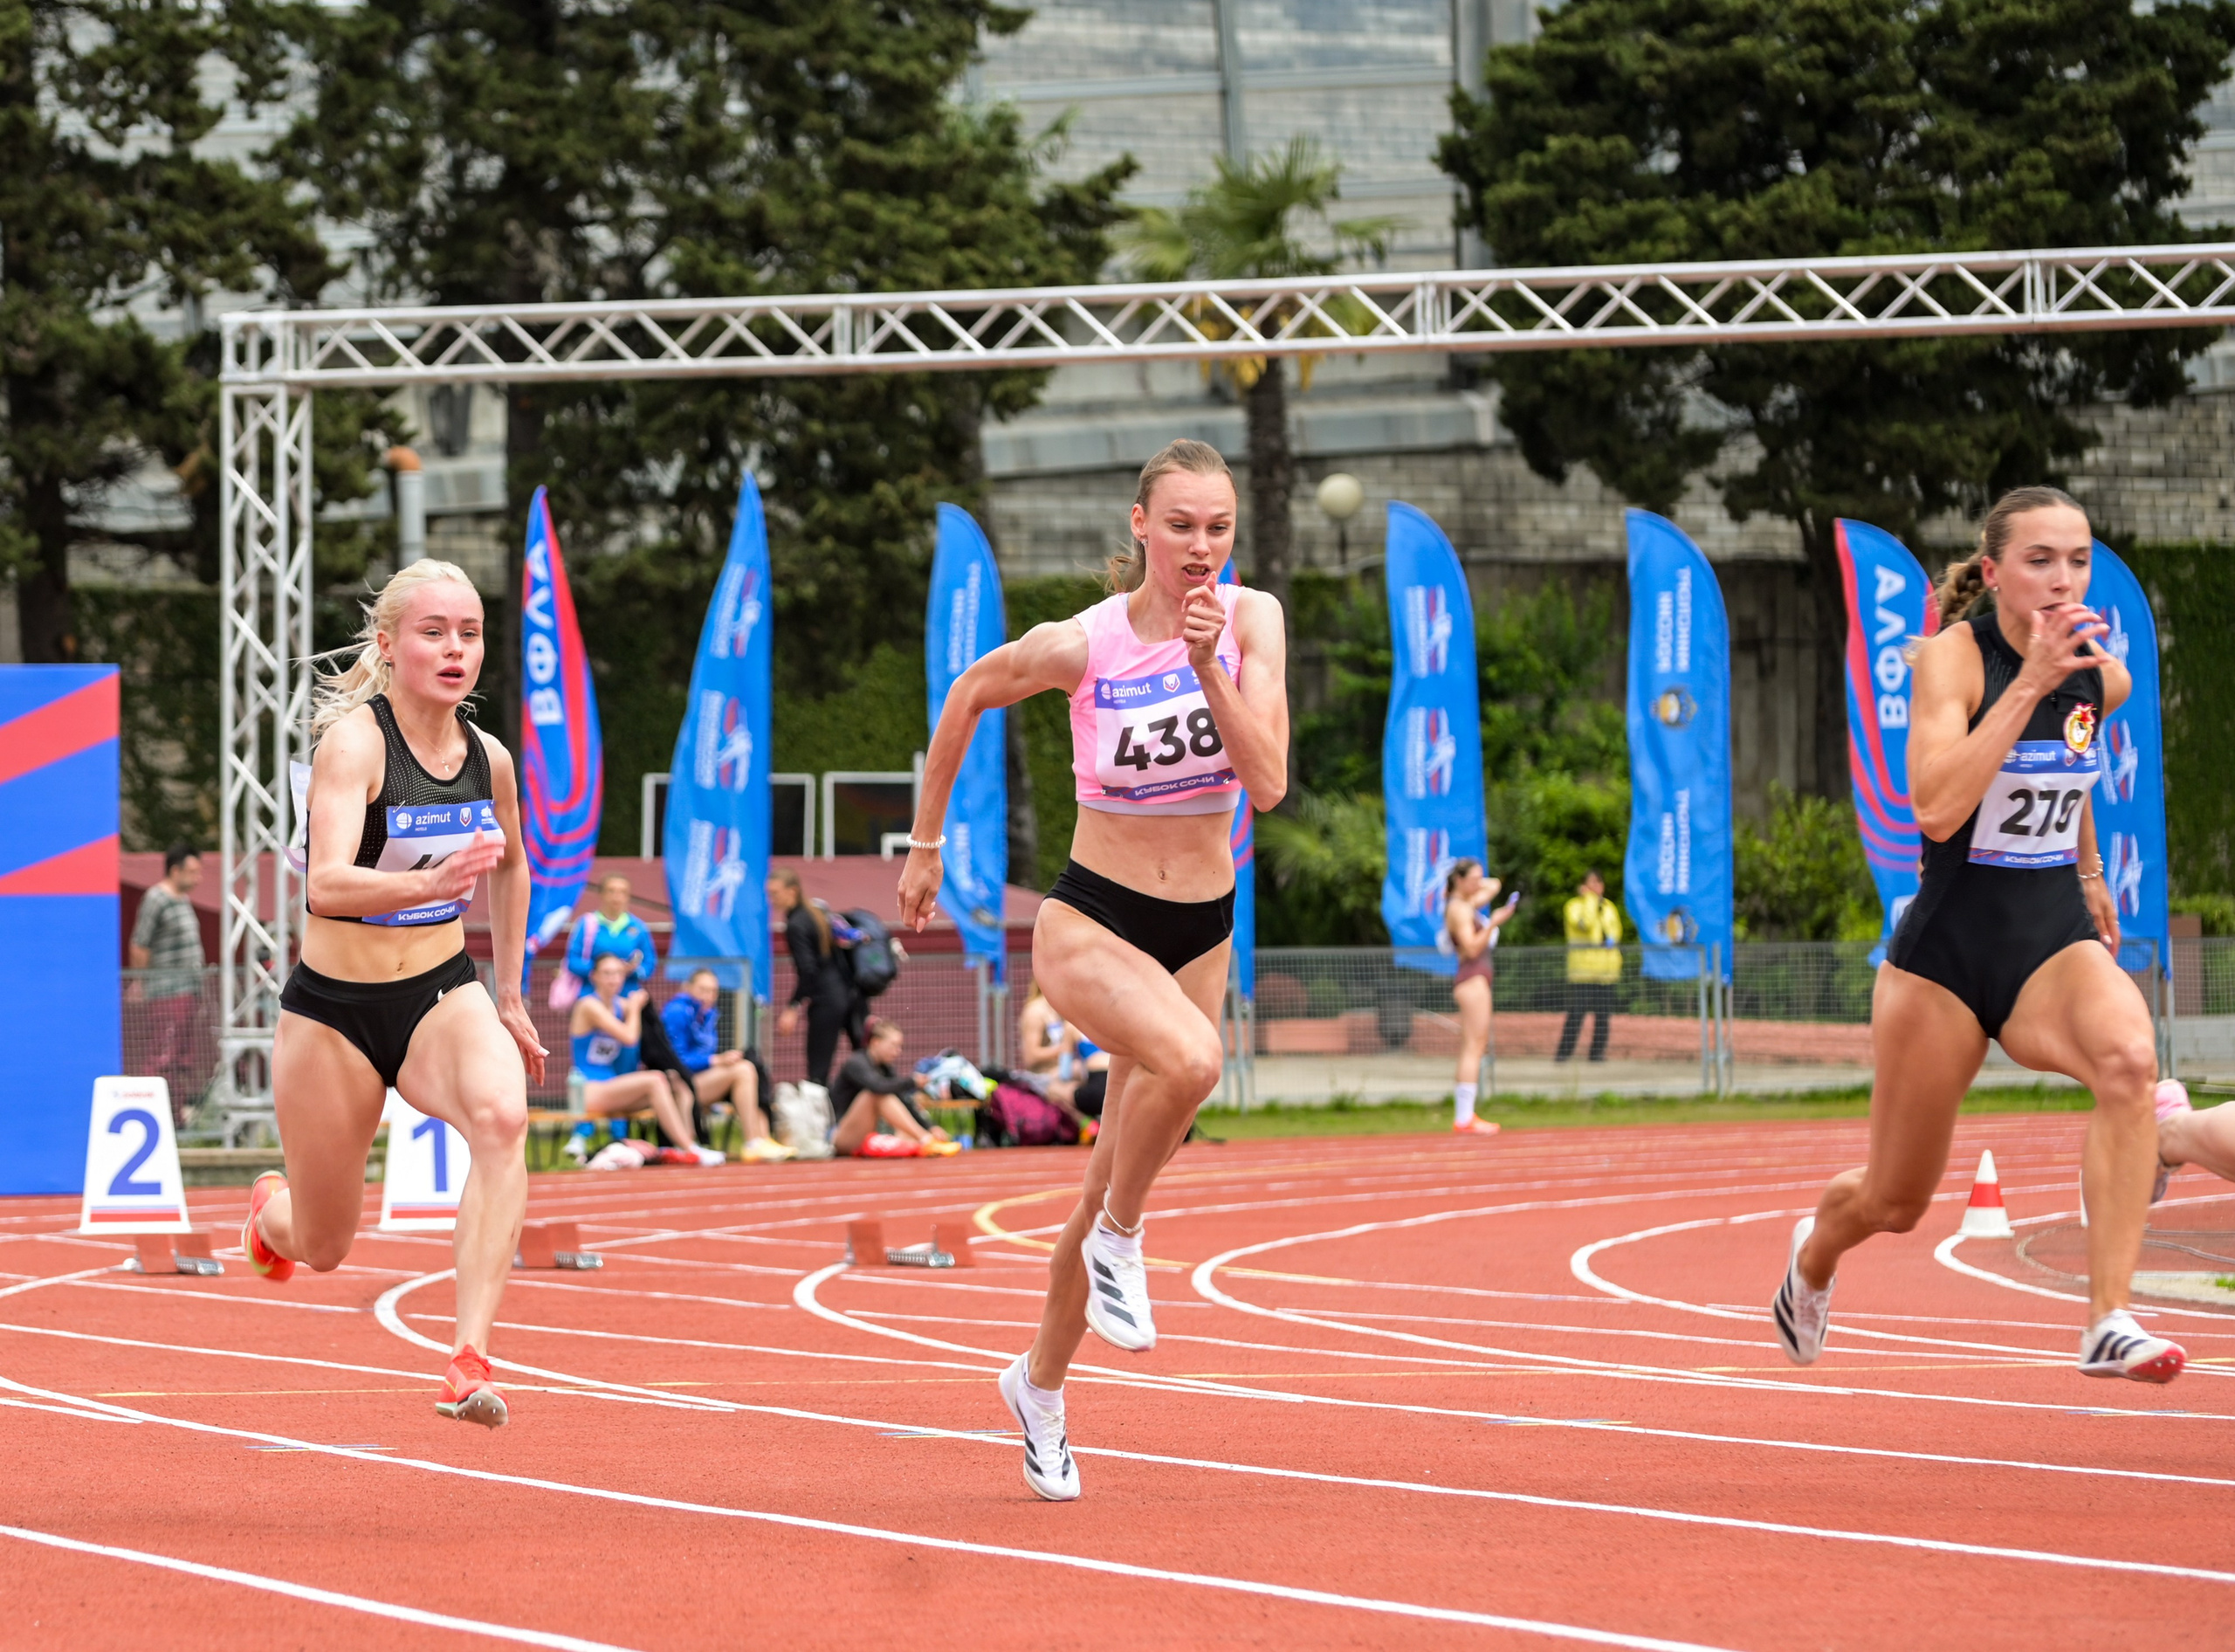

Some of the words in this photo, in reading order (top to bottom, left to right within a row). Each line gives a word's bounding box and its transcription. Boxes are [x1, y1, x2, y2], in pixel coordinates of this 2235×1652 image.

[1111, 682, 1152, 699] azimut
[1114, 707, 1224, 771] 438
[2020, 748, 2057, 762] azimut
[1134, 782, 1179, 796] КУБОК
[1179, 775, 1214, 788] СОЧИ
[415, 811, 451, 826] azimut
[398, 910, 435, 921] КУБОК
[435, 905, 456, 917] СОЧИ
[107, 1108, 162, 1196] 2
[413, 1116, 448, 1192] 1
